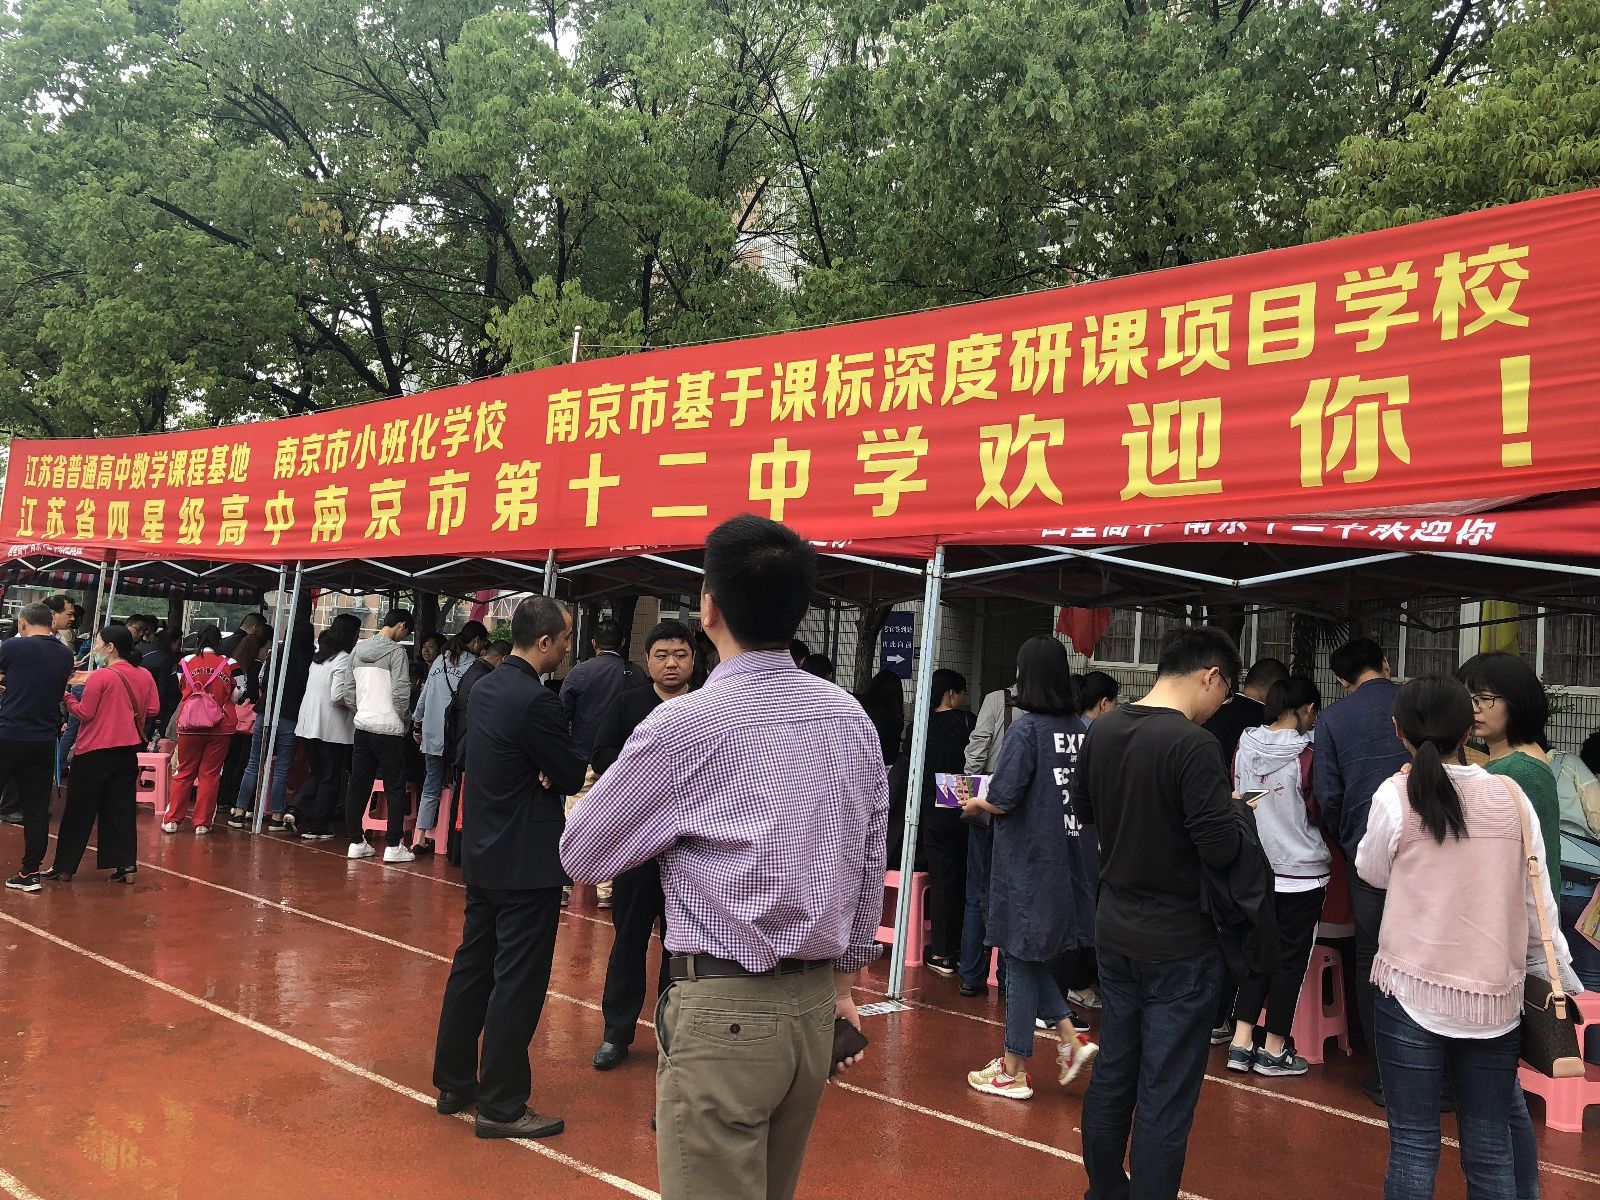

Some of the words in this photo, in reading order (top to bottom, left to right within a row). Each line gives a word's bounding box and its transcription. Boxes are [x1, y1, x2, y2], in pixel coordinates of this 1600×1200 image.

[24, 442, 252, 490] 江苏省普通高中数学课程基地
[273, 399, 508, 480] 南京市小班化学校
[545, 242, 1530, 445] 南京市基于课标深度研课项目学校
[1052, 767, 1075, 786] EC
